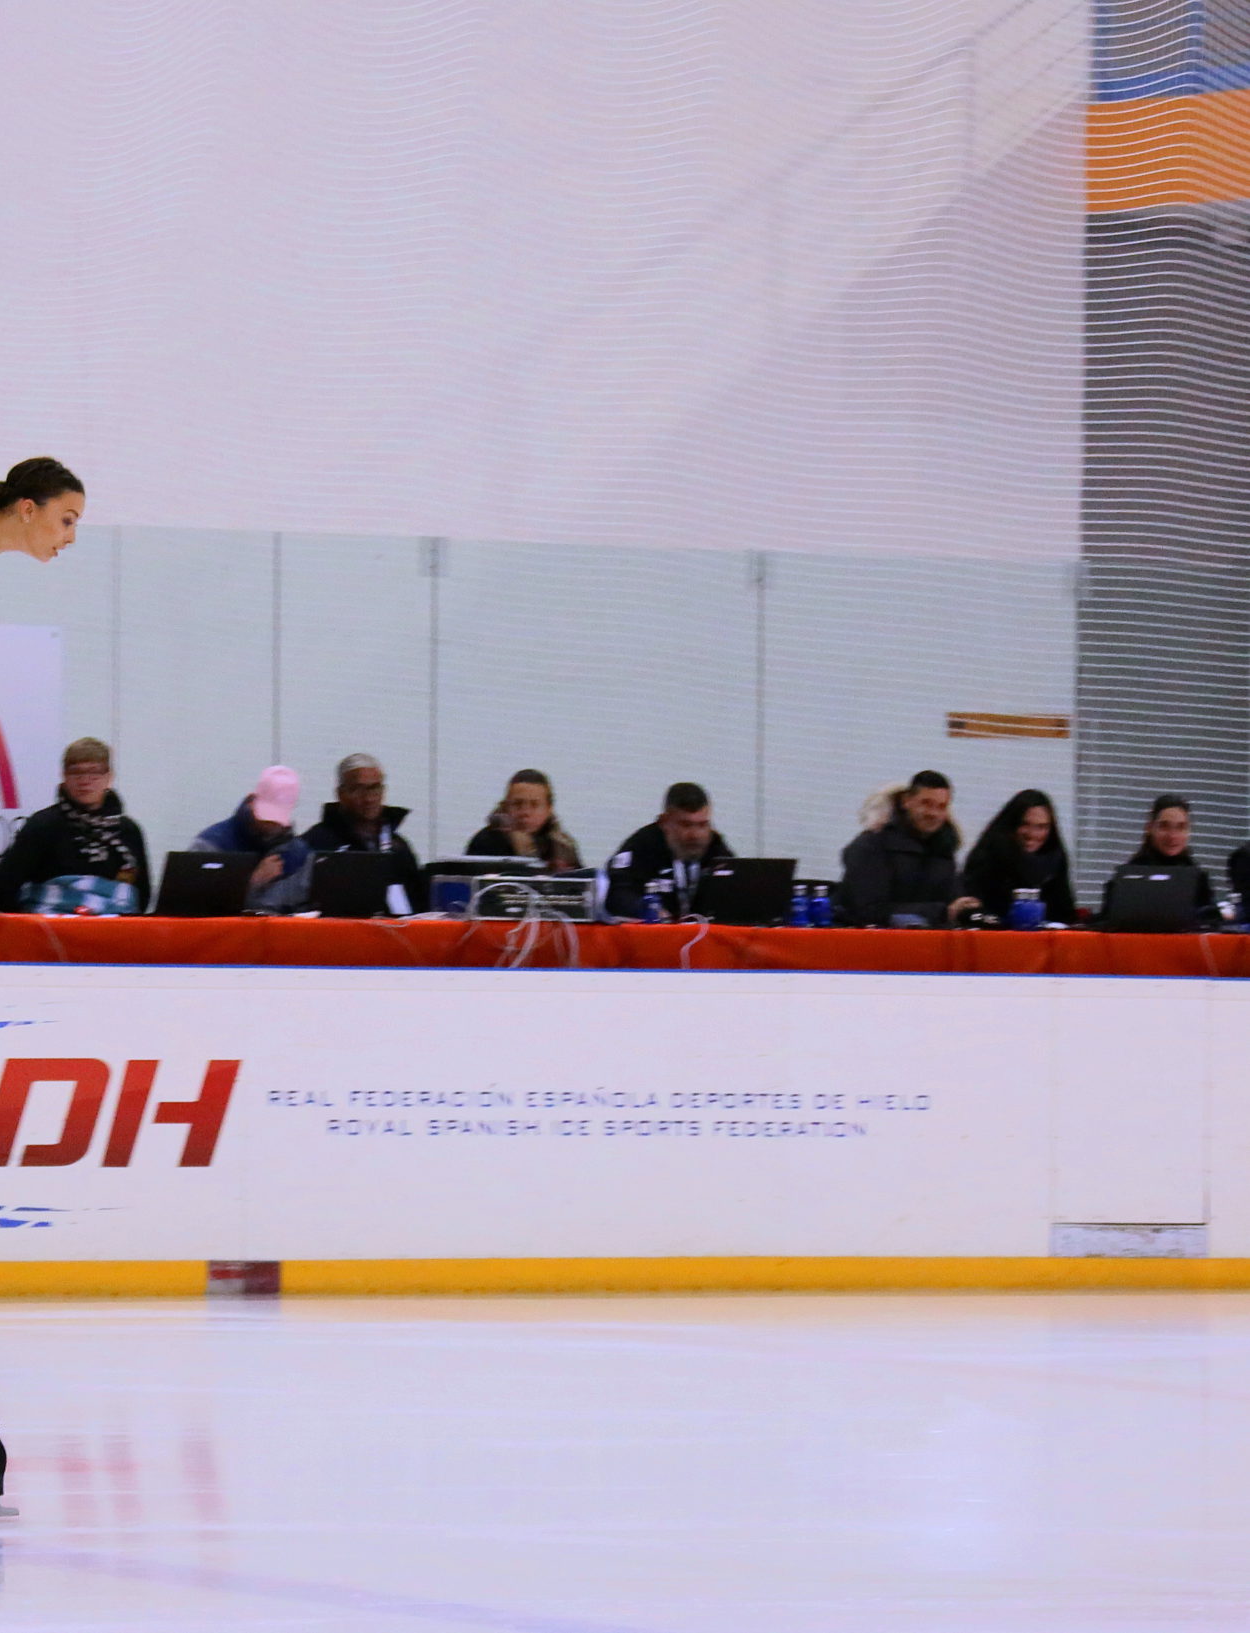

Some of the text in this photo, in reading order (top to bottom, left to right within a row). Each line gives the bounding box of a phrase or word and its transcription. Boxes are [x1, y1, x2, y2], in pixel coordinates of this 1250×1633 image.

[267, 1084, 932, 1111] REAL FEDERACIÓN ESPAÑOLA DEPORTES DE HIELO
[326, 1118, 868, 1138] ROYAL SPANISH ICE SPORTS FEDERATION
